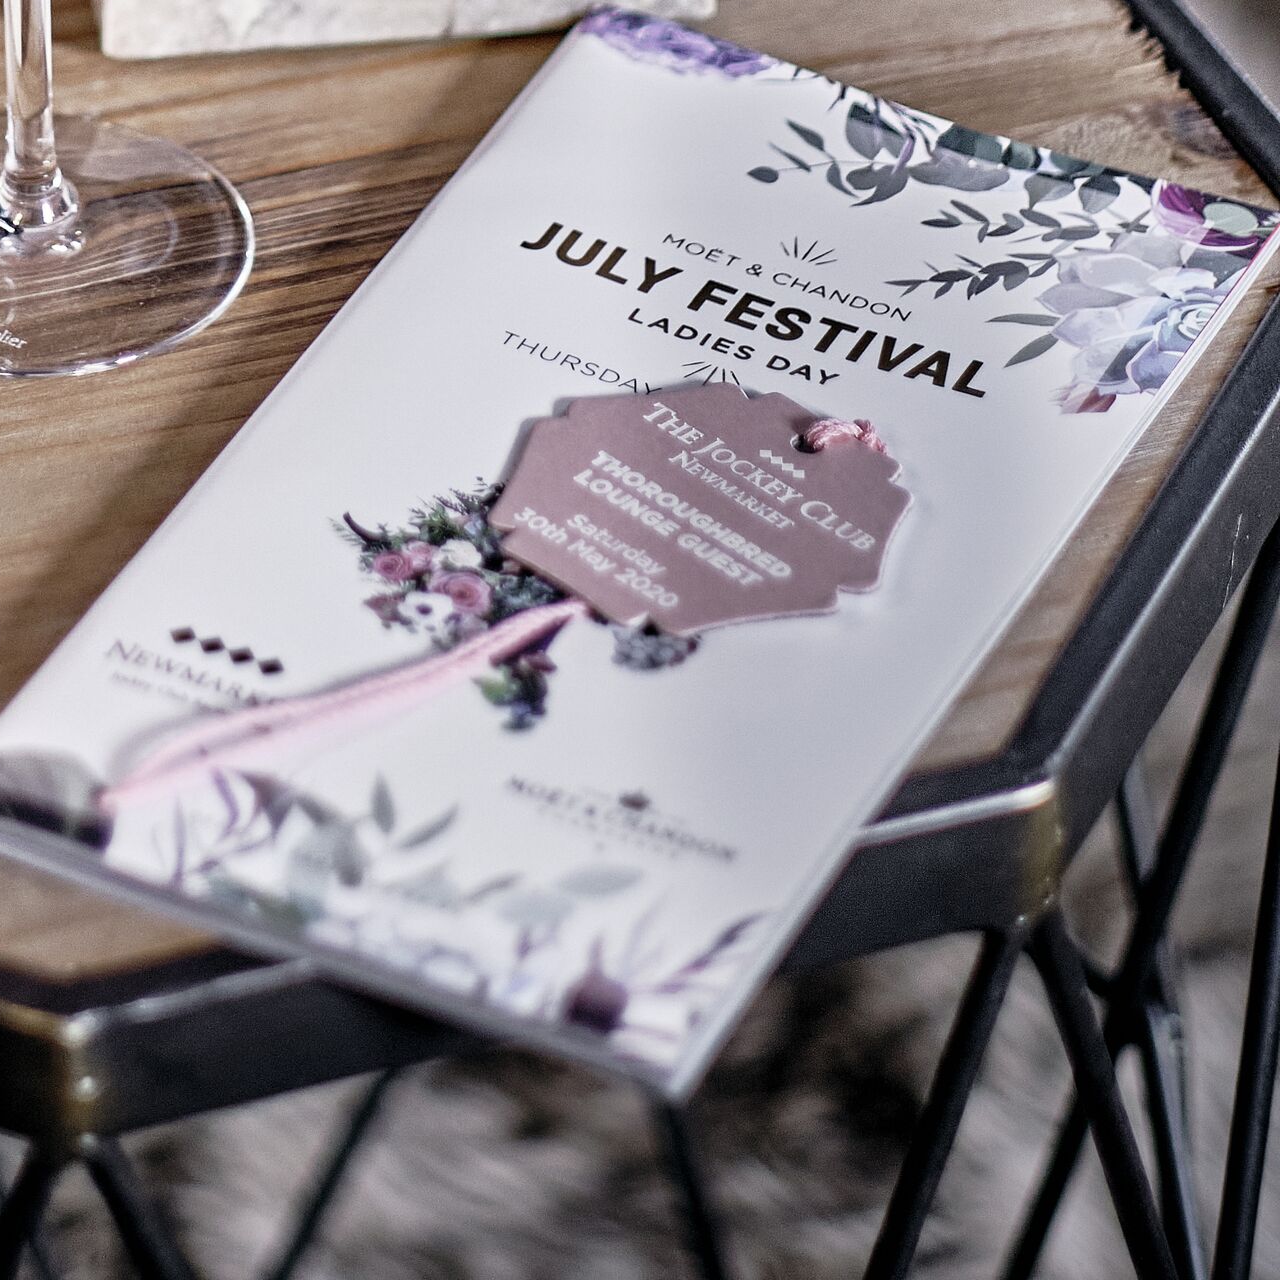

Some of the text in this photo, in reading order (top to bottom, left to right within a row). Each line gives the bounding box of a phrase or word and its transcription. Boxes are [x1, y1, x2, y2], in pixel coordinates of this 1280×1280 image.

[520, 221, 987, 398] JULY FESTIVAL
[745, 262, 763, 277] &
[772, 271, 913, 323] CHANDON
[503, 330, 662, 396] THURSDAY
[627, 307, 840, 386] LADIES DAY
[590, 450, 793, 579] THOROUGHBRED
[642, 402, 877, 552] THE JOCKEY CLUB
[669, 450, 795, 530] NEWMARKET
[513, 506, 680, 609] 30th May 2020
[567, 512, 667, 577] Saturday
[573, 469, 766, 587] LOUNGE GUEST
